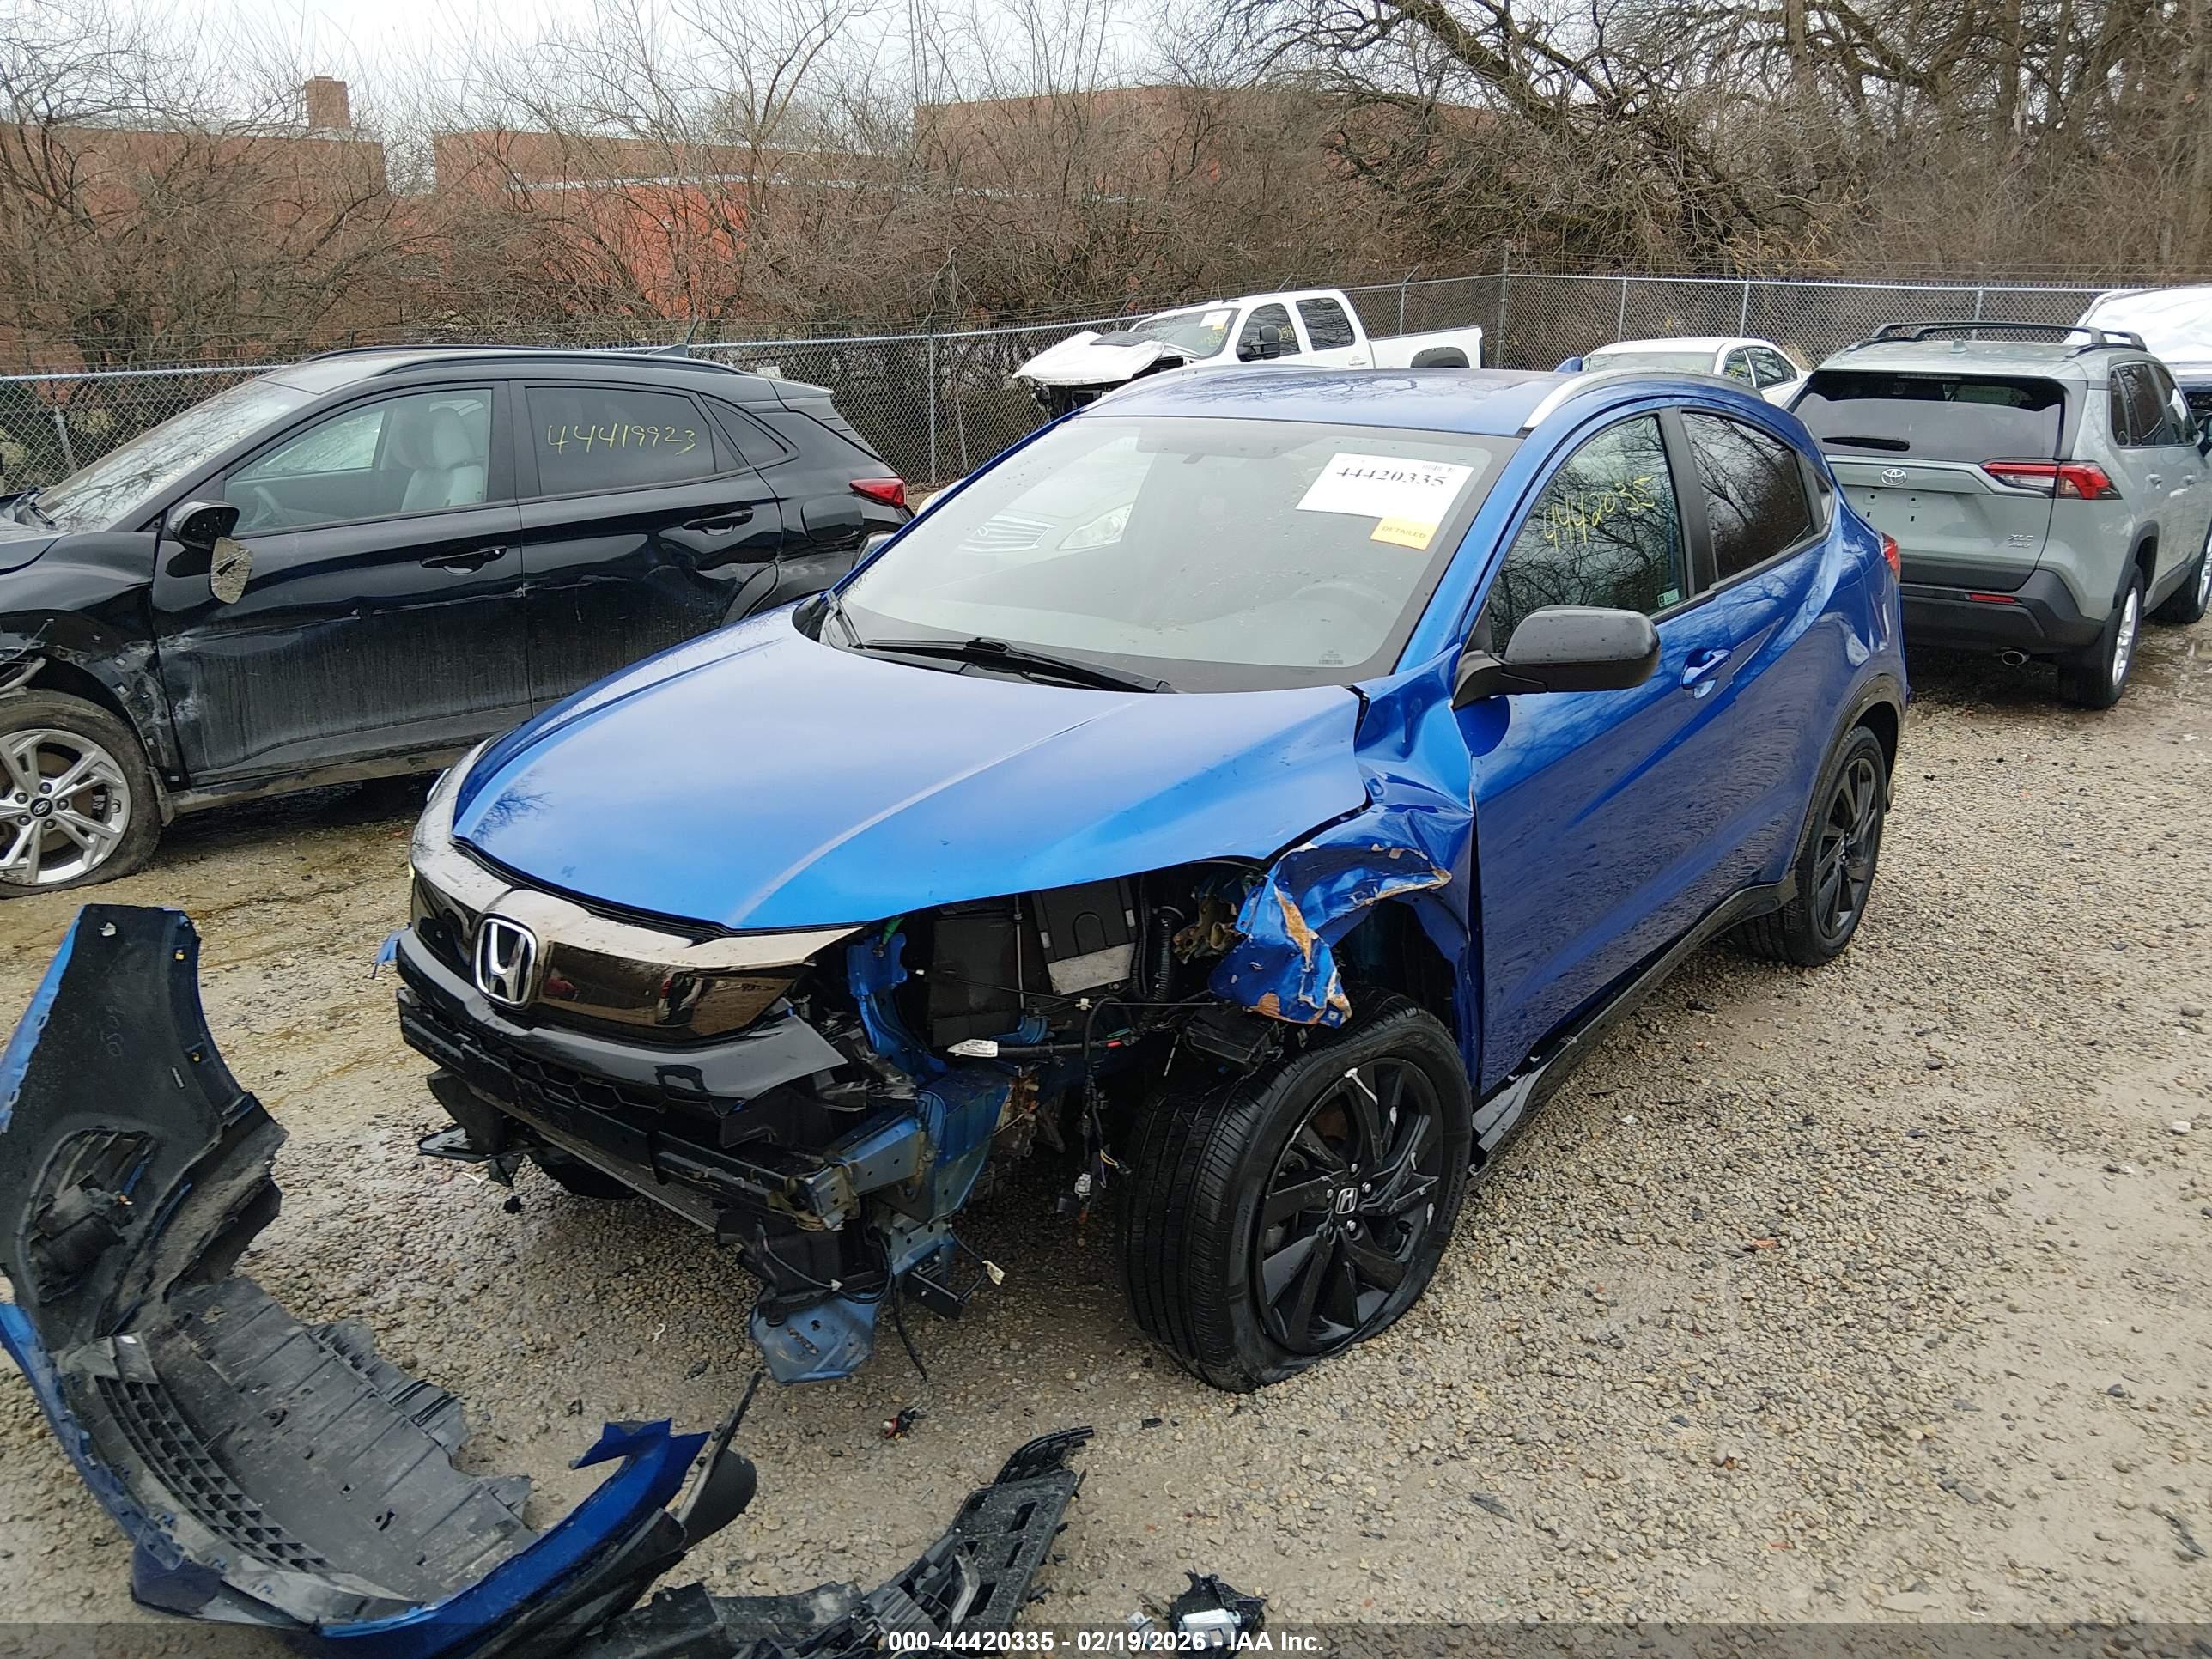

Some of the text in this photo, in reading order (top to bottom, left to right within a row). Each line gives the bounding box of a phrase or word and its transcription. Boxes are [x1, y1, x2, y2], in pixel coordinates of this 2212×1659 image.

[547, 422, 696, 457] 44419923
[1336, 466, 1449, 488] 44420335
[1381, 525, 1427, 539] DETAILED
